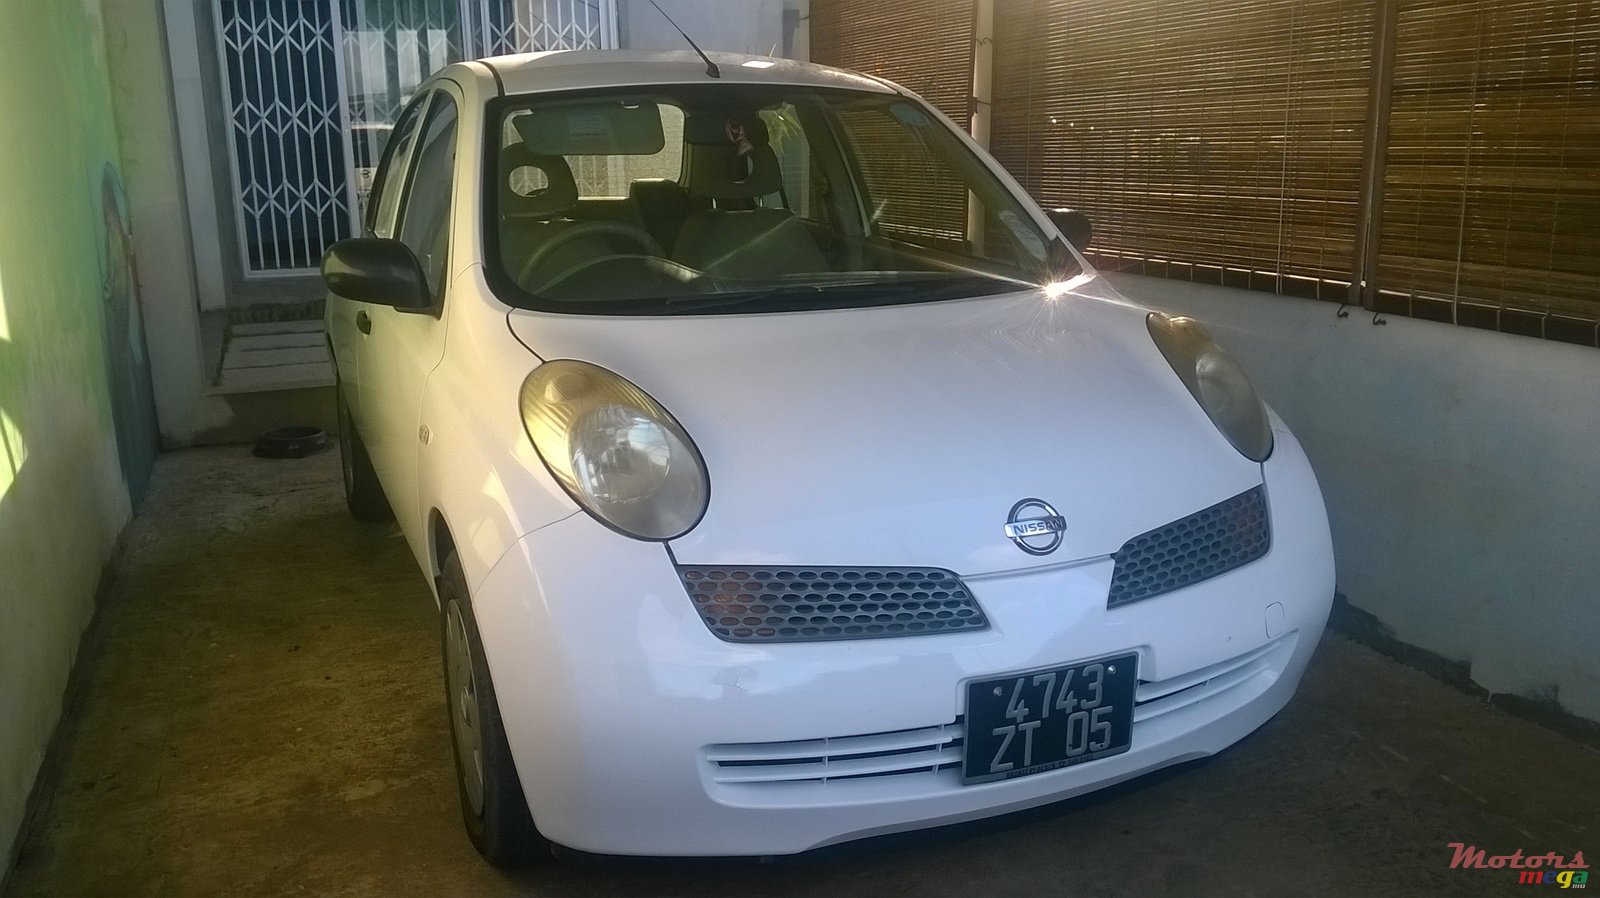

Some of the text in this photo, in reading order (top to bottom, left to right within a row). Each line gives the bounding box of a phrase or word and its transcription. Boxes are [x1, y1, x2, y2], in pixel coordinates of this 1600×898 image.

[1013, 519, 1062, 534] NISSAN
[1005, 663, 1104, 723] 4743
[990, 720, 1041, 773] ZT
[1065, 705, 1113, 757] 05
